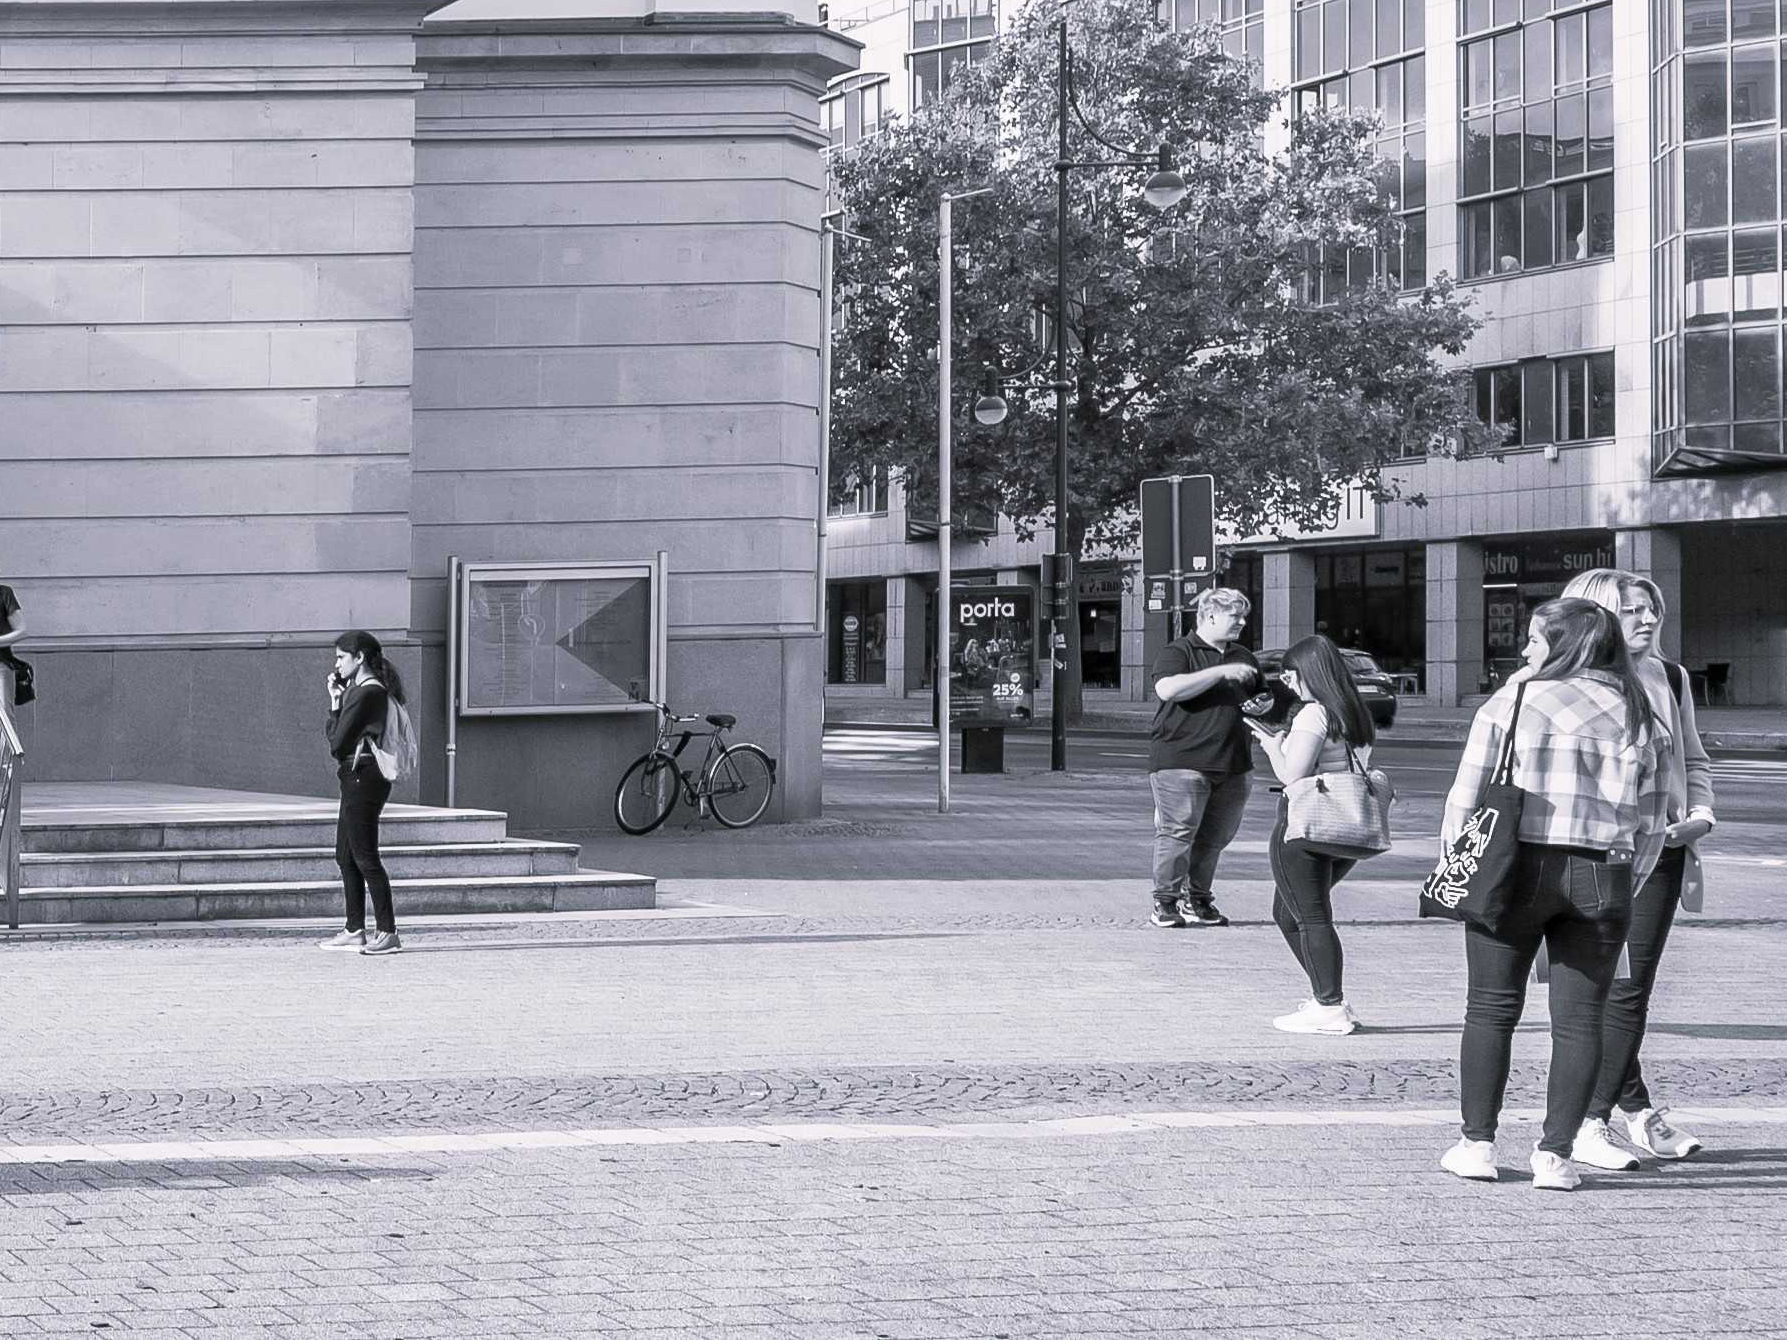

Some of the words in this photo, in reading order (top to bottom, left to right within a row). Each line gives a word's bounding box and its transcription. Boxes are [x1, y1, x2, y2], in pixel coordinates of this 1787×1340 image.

[1483, 550, 1518, 575] istro
[1563, 552, 1593, 570] sun
[960, 597, 1015, 623] porta
[992, 683, 1024, 696] 25%
